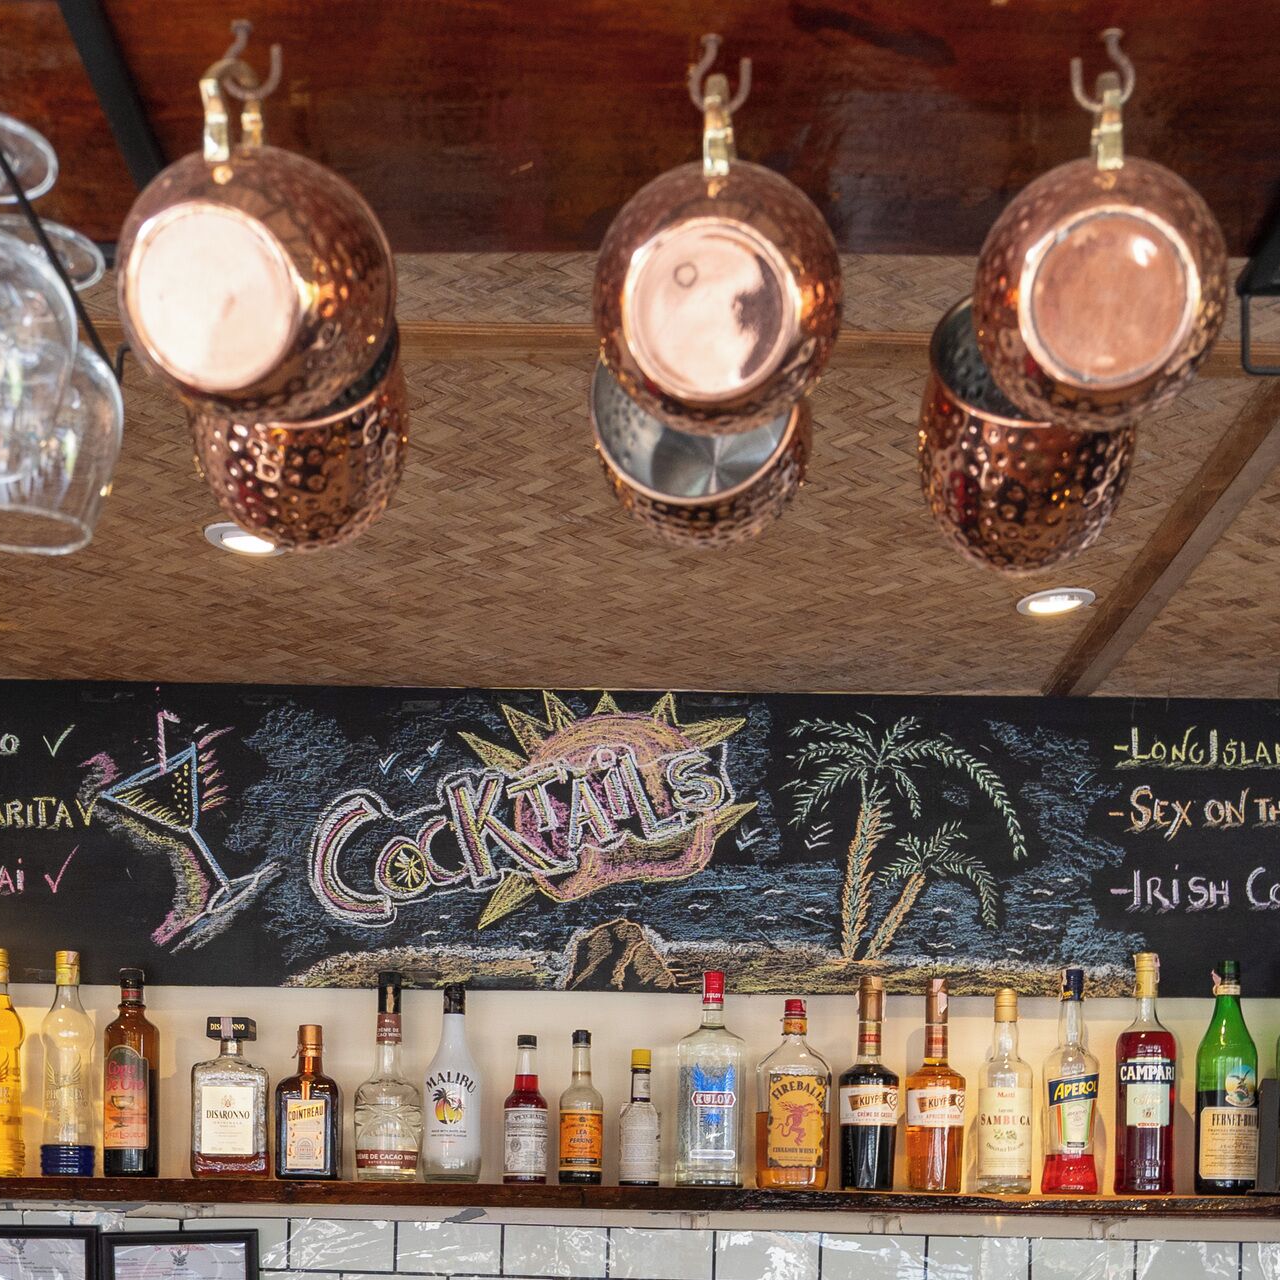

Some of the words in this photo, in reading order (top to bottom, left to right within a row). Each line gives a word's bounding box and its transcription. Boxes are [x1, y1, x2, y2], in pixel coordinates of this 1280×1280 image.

[1120, 1064, 1175, 1081] CAMPARI
[425, 1071, 477, 1094] MALIBU
[1054, 1081, 1098, 1101] APEROL
[695, 1093, 732, 1105] KULOV
[771, 1080, 825, 1105] FIREBALL
[206, 1110, 250, 1120] DISARONNO
[287, 1104, 324, 1122] COINTREAU
[980, 1114, 1031, 1126] SAMBUCA
